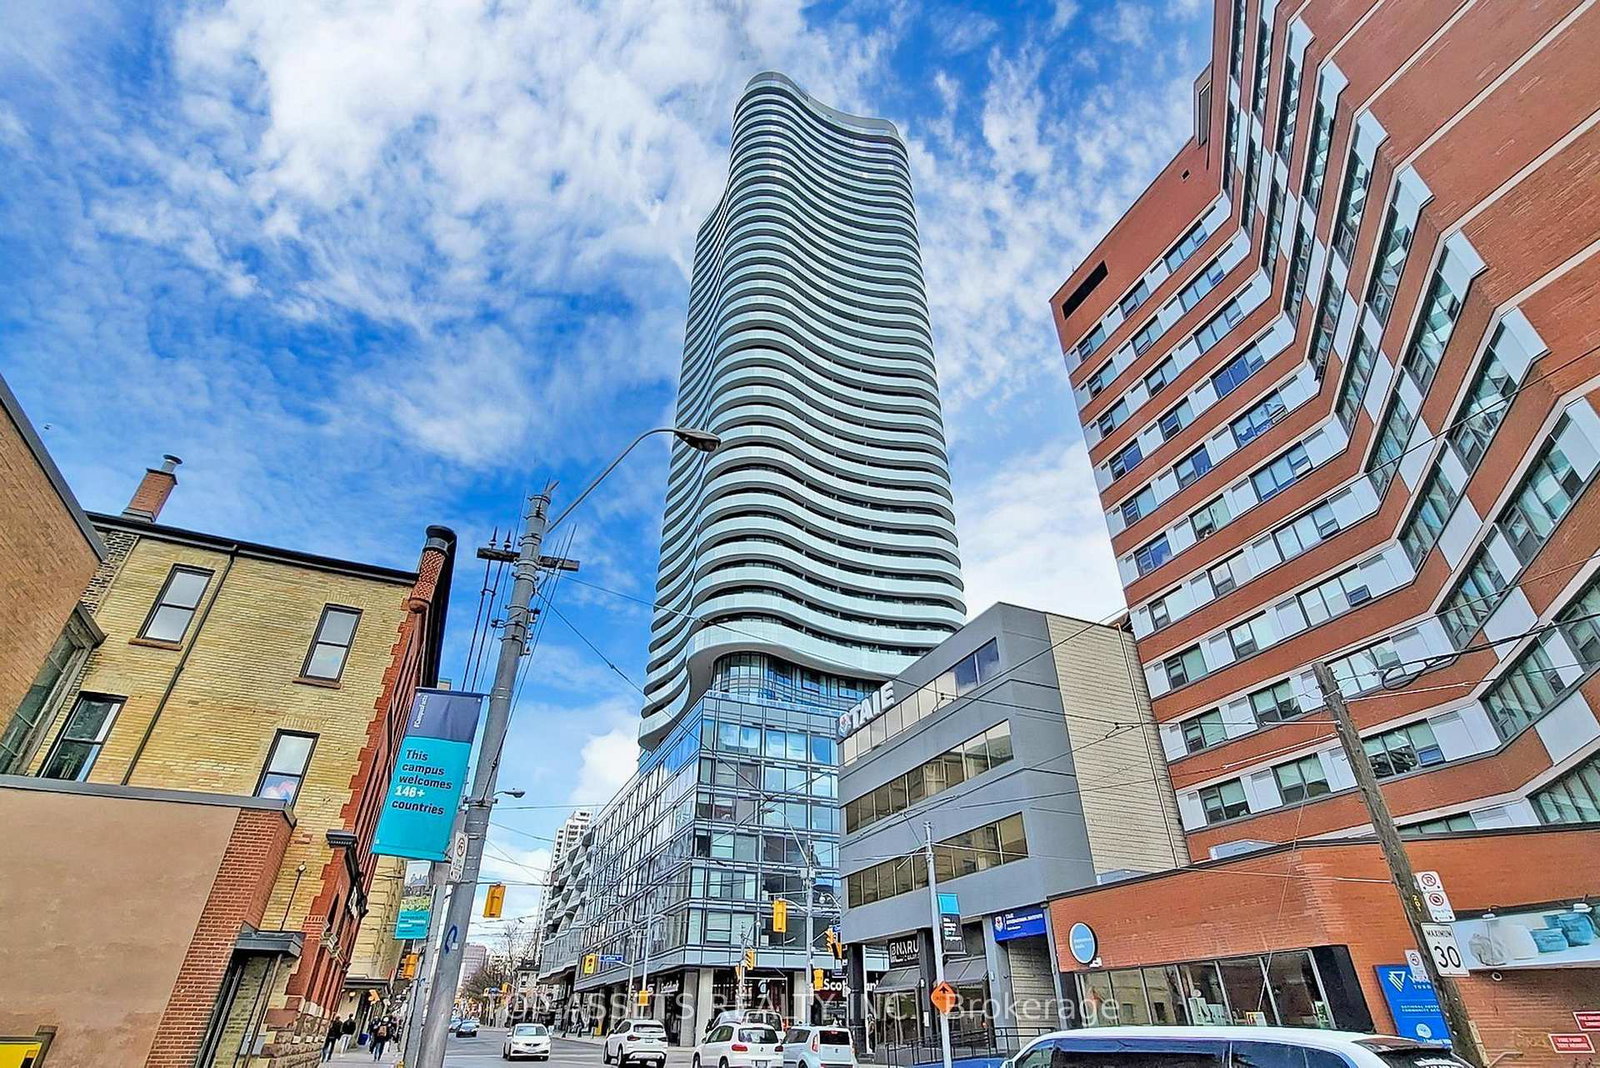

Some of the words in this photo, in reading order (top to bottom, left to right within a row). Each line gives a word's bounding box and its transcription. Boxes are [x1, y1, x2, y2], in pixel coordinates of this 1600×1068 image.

[850, 681, 895, 729] TAIE
[406, 749, 428, 761] This
[402, 763, 445, 775] campus
[399, 774, 453, 789] welcomes
[391, 800, 445, 814] countries
[1426, 929, 1452, 938] MAXIMUM
[1434, 945, 1461, 968] 30
